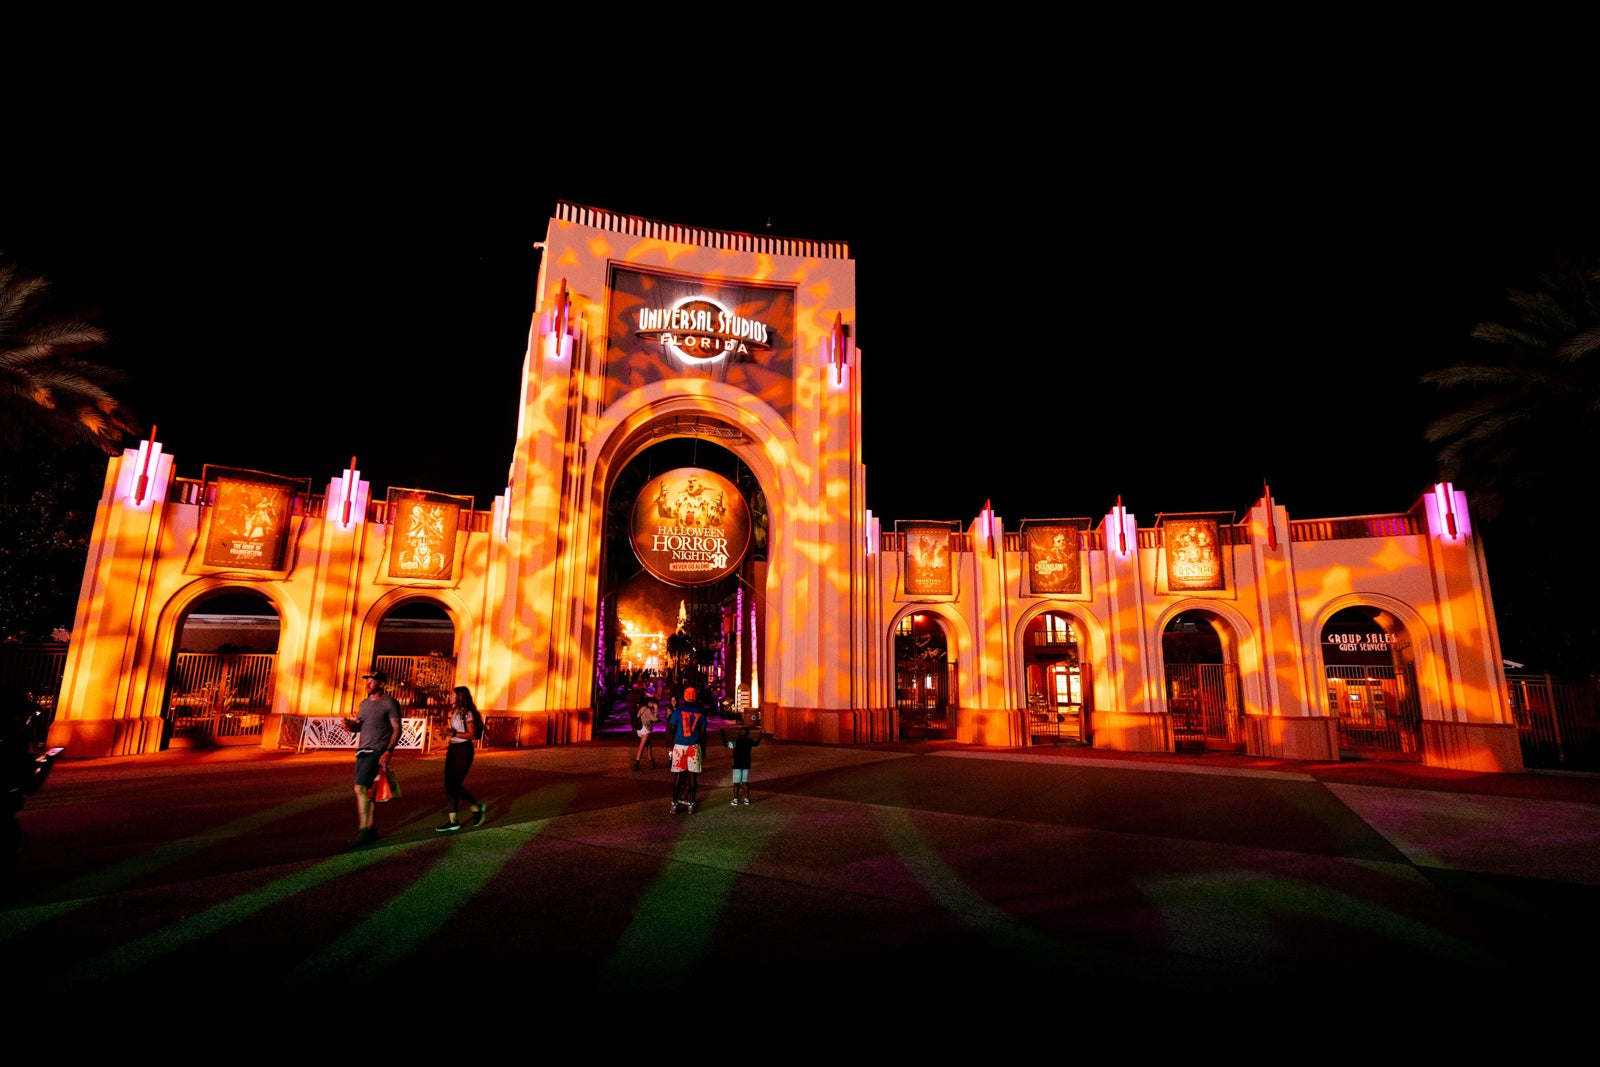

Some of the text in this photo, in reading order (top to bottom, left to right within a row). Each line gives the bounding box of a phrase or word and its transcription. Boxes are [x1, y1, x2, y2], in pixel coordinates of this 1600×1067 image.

[639, 307, 768, 343] UNIVERSAL STUDIOS
[660, 334, 748, 354] FLORIDA
[657, 525, 725, 537] HALLOWEEN
[651, 534, 730, 558] HORROR
[672, 550, 727, 568] NIGHTS 30
[1328, 633, 1397, 643] GROUP SALES
[1339, 643, 1388, 652] GUEST SERVICES
